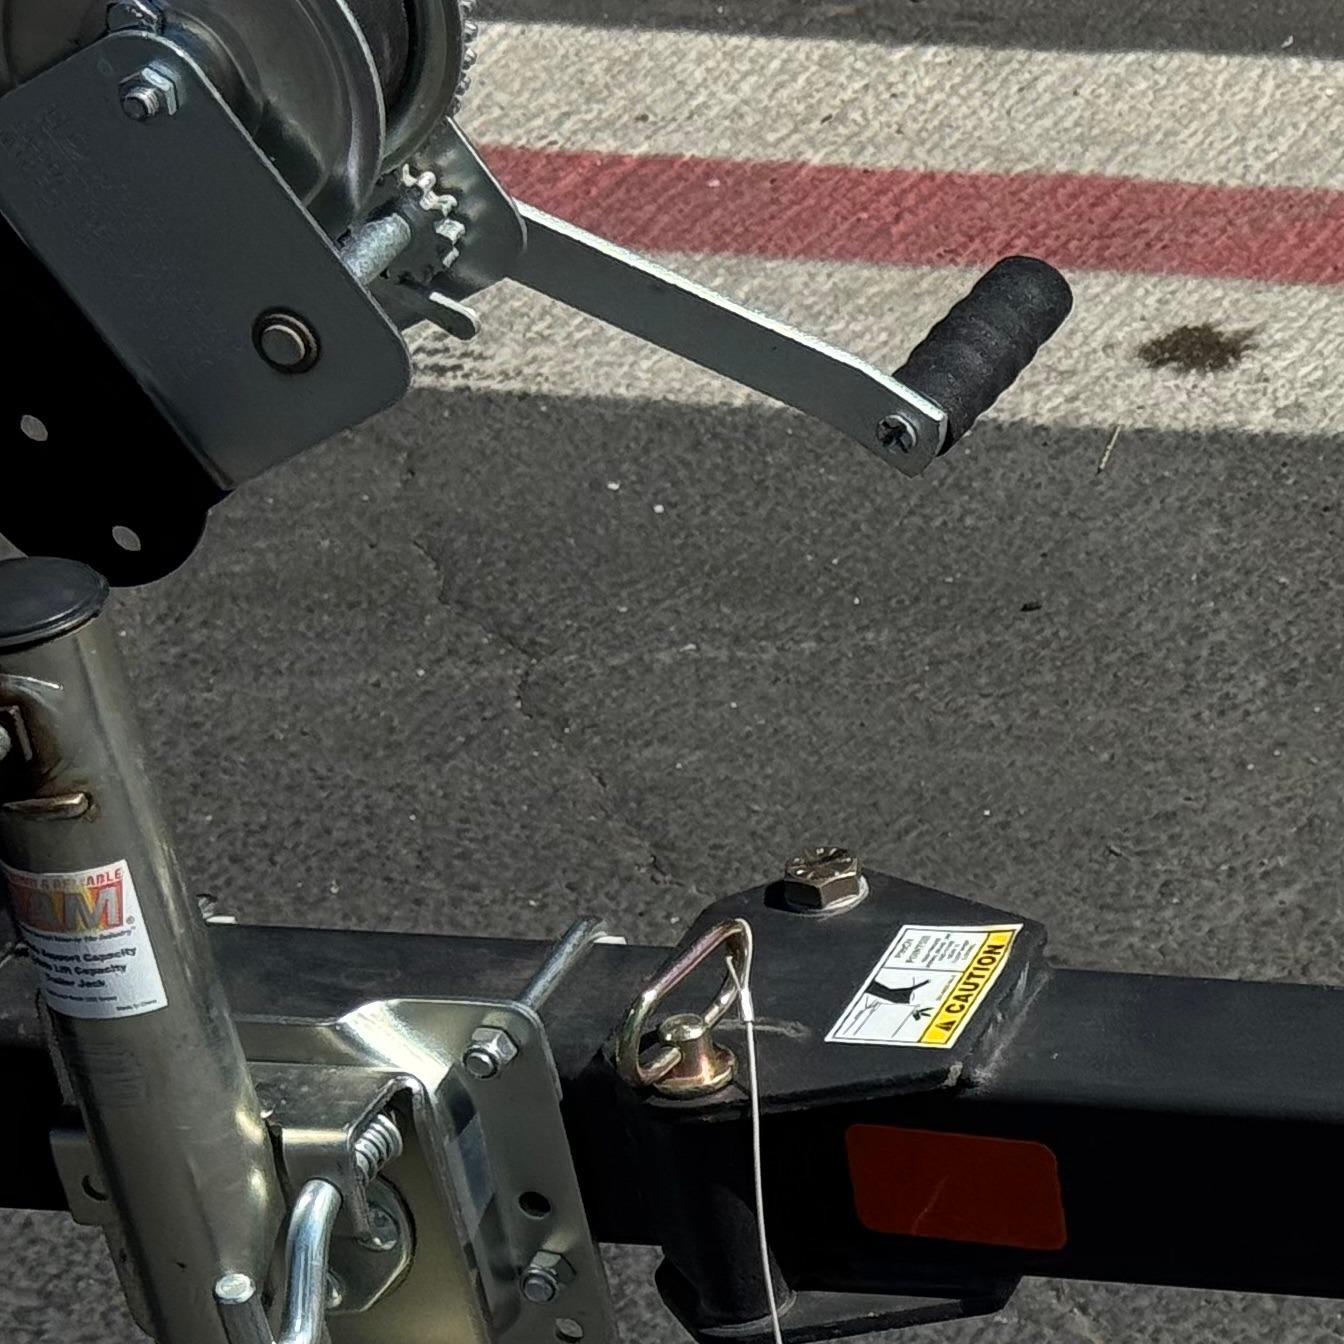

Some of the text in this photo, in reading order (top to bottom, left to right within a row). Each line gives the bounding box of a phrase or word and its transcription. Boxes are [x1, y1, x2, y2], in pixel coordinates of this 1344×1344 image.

[83, 947, 137, 963] Capacity
[74, 964, 127, 976] Capacity
[945, 942, 1005, 1014] CAUTION
